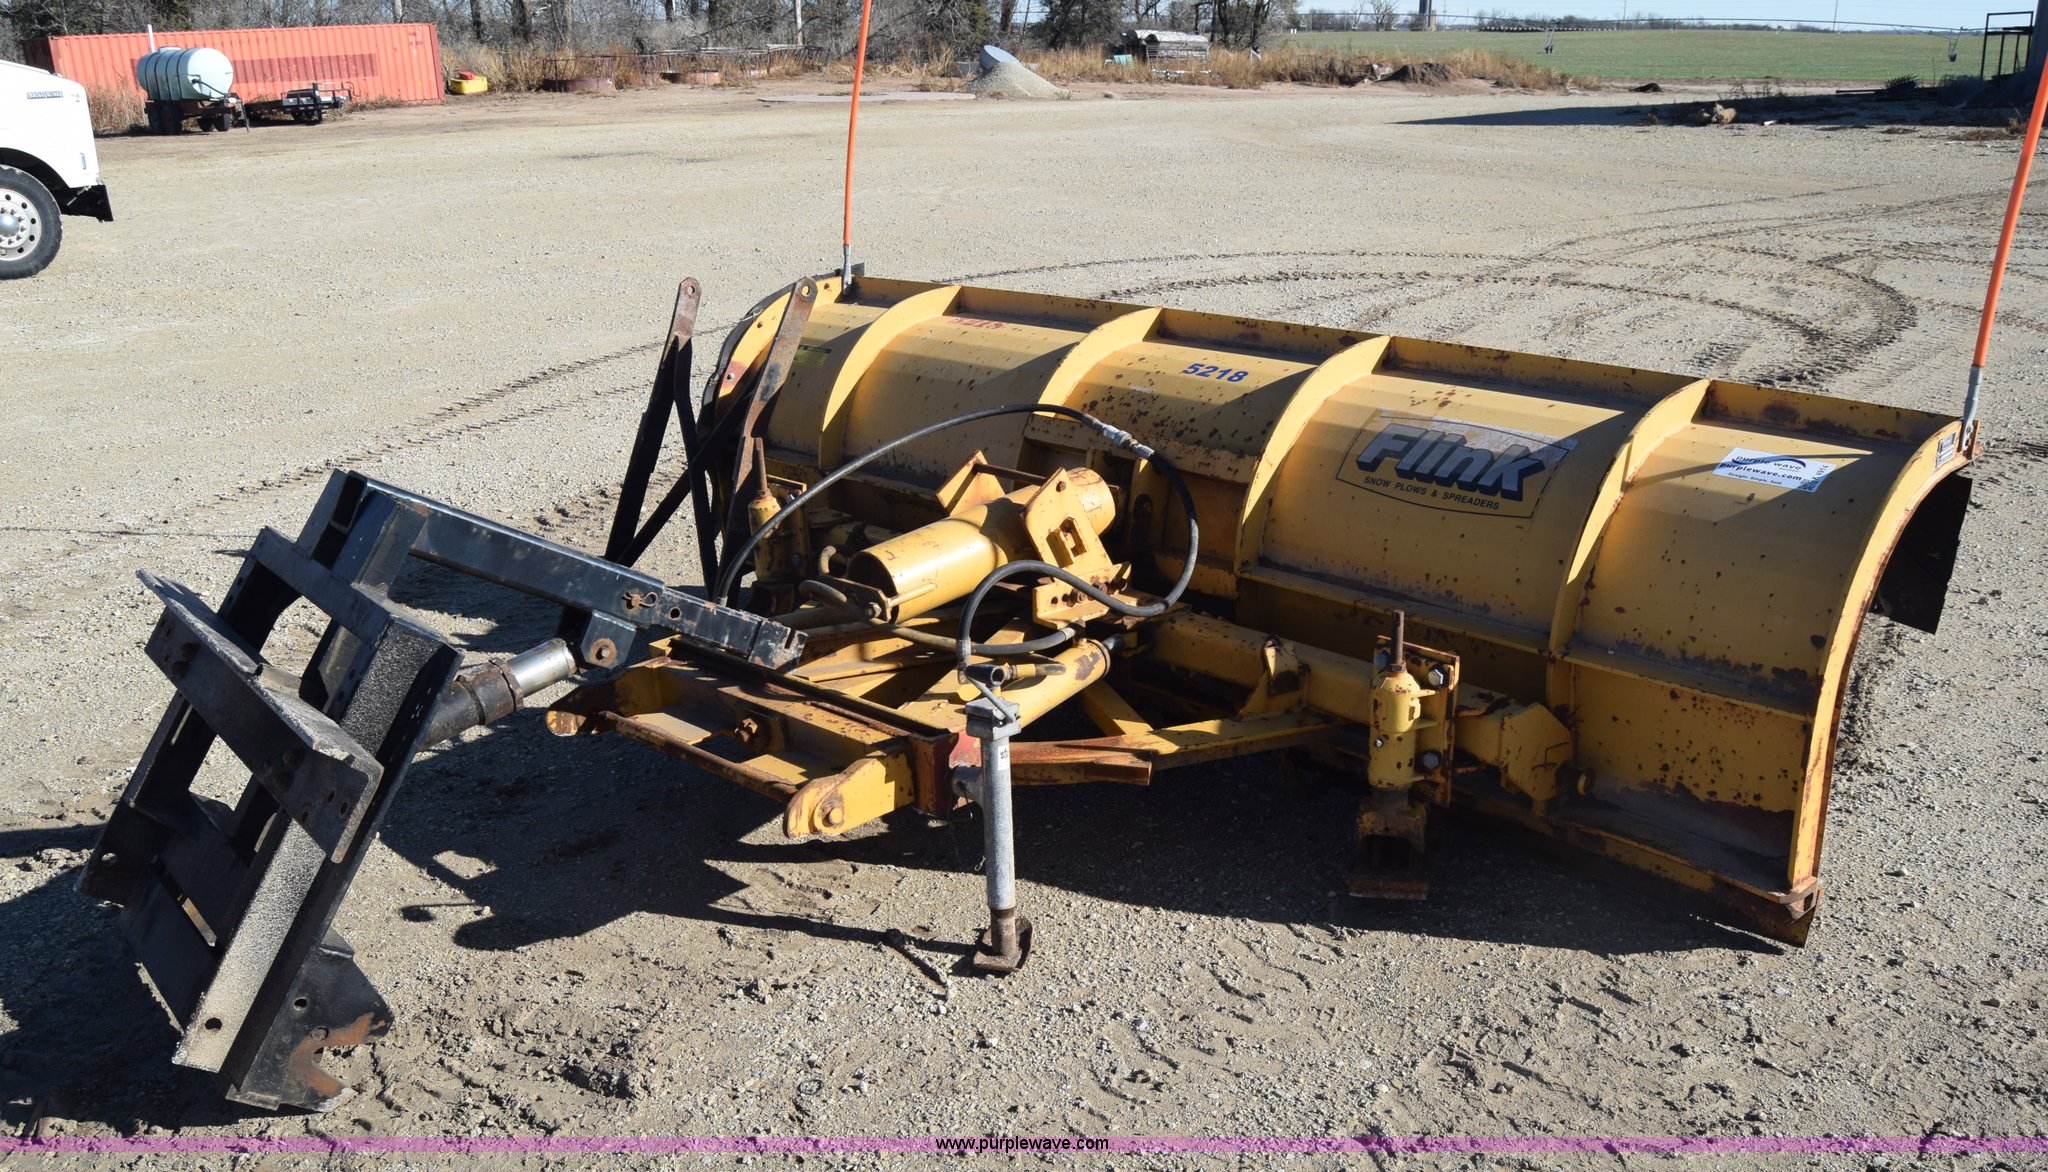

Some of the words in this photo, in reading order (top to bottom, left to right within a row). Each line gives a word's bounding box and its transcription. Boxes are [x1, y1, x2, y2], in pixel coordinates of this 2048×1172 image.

[1183, 363, 1249, 382] 5218
[1356, 423, 1546, 501] Flink
[1719, 462, 1803, 481] purplewave.com
[1773, 462, 1802, 470] wave
[1363, 476, 1391, 488] SNOW
[1395, 482, 1427, 495] PLOWS
[1431, 489, 1438, 498] &
[1442, 491, 1500, 510] SPREADERS
